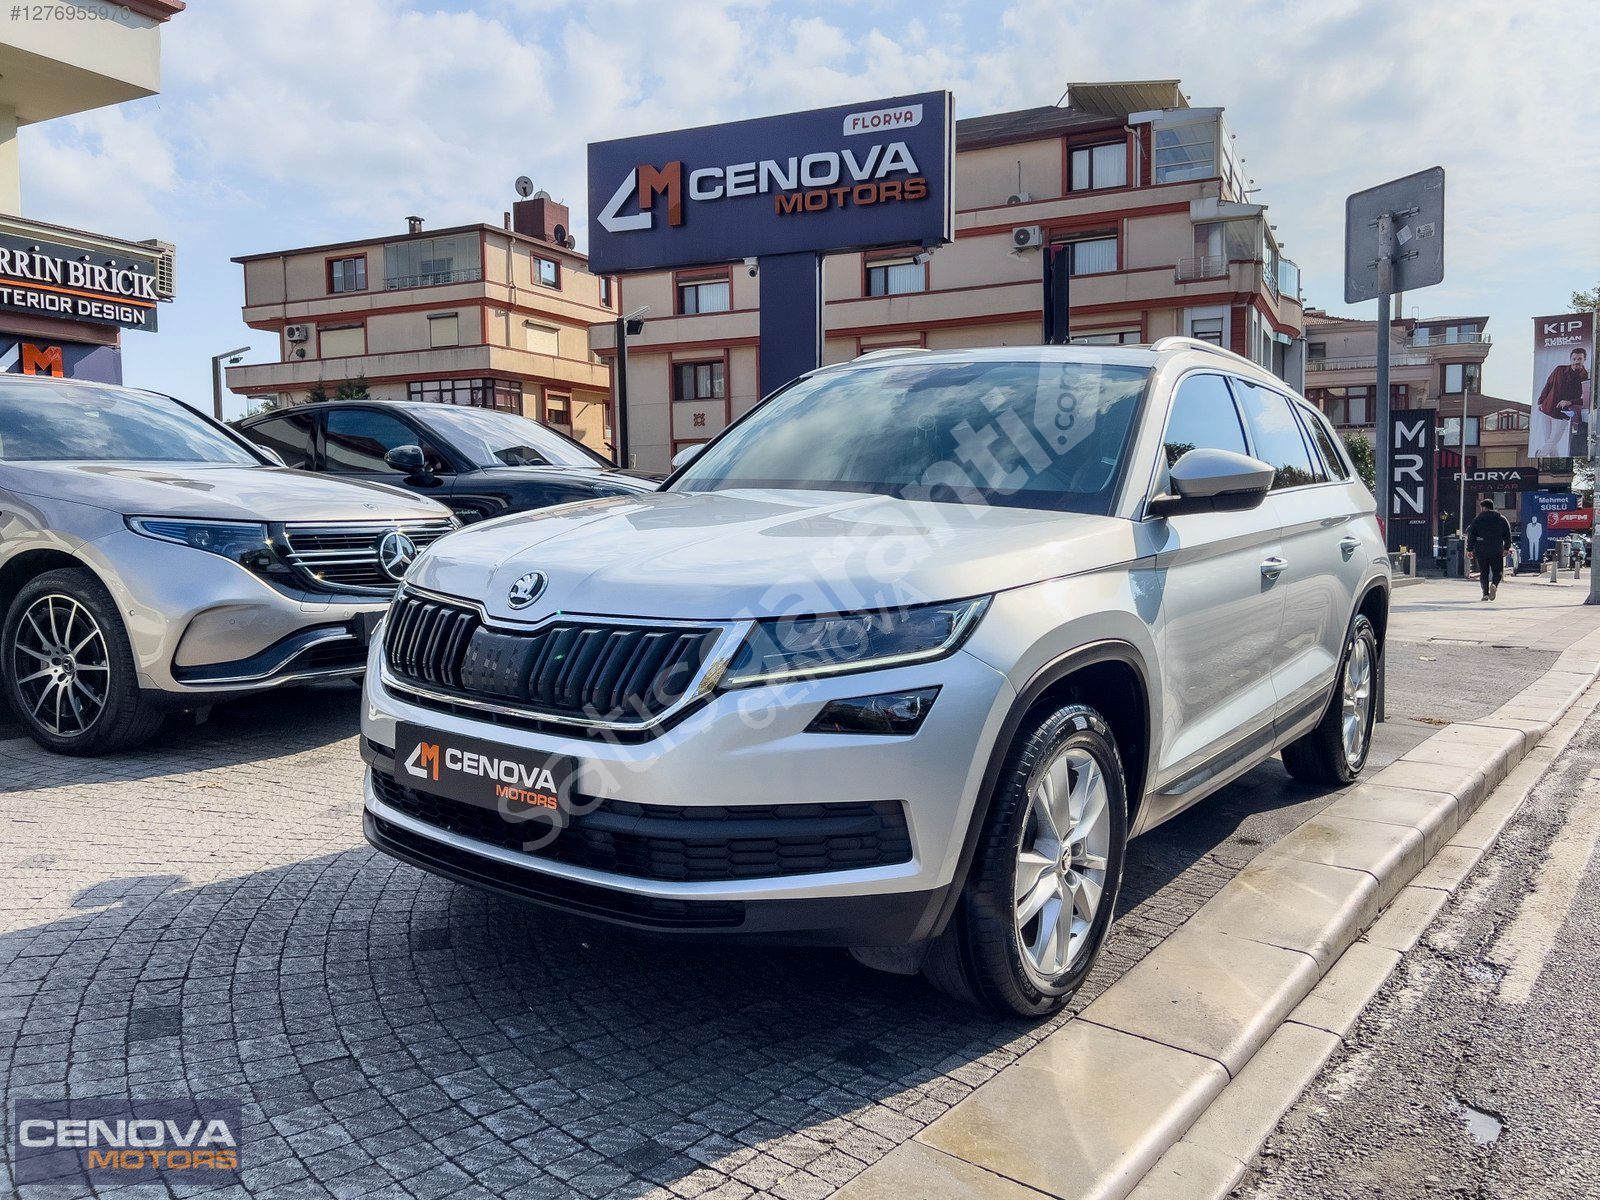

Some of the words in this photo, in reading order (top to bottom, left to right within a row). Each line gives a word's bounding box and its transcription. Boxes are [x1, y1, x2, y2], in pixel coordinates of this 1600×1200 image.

[852, 110, 914, 131] FLORYA
[689, 141, 919, 201] CENOVA
[775, 177, 927, 215] MOTORS
[78, 300, 146, 324] DESIGN
[1393, 419, 1426, 514] MRN
[1453, 471, 1521, 481] FLORYA
[1538, 496, 1569, 504] Mehmet
[1540, 503, 1568, 511] SÜSLÜ
[445, 747, 557, 794] CENOVA
[495, 784, 557, 811] MOTORS
